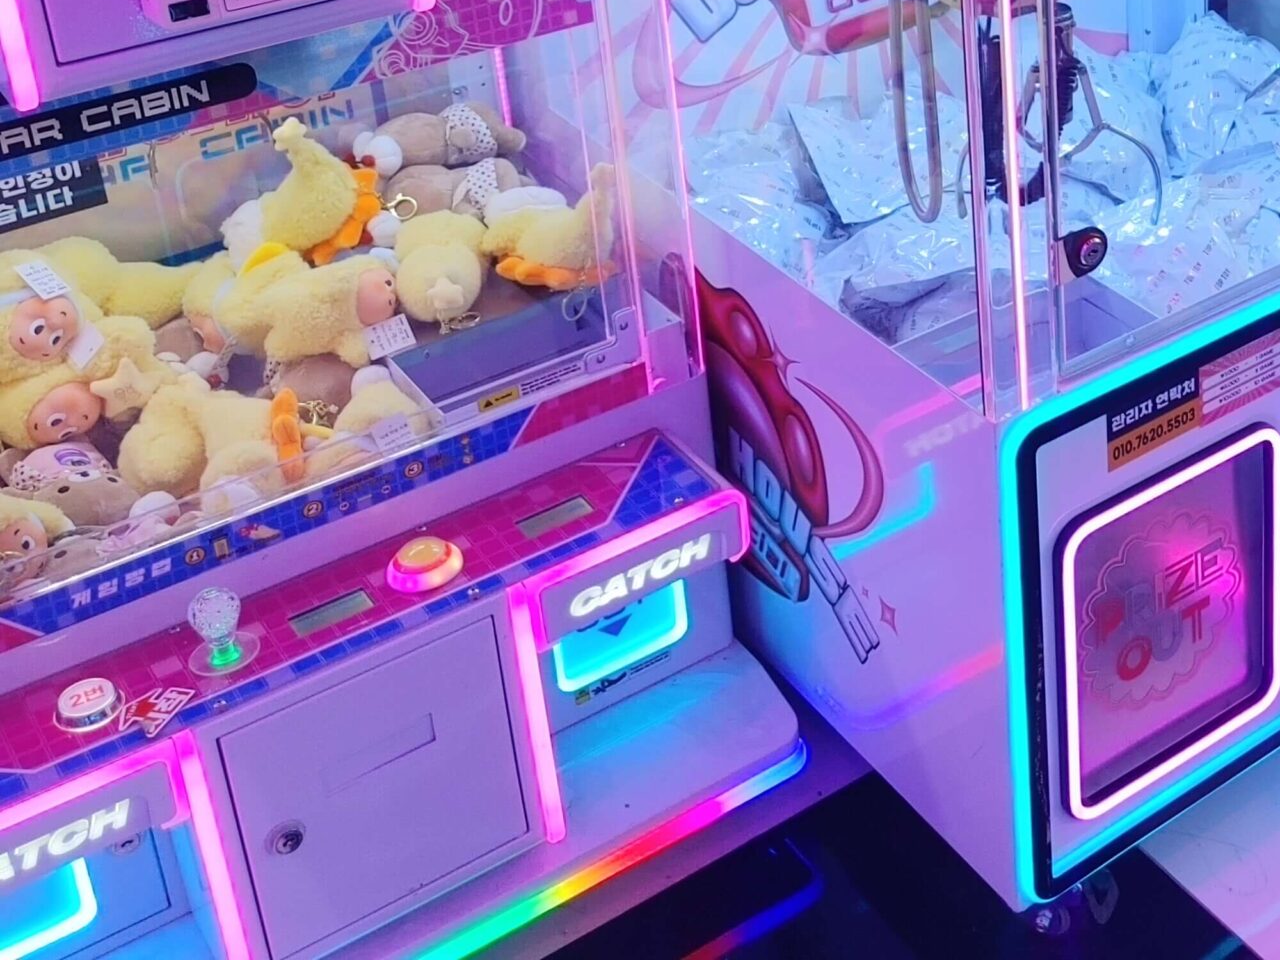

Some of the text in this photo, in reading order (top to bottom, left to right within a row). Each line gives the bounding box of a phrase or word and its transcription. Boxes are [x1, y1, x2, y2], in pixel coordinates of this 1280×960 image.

[80, 79, 211, 134] CABIN
[1111, 376, 1196, 432] 관리자 연락처
[1112, 407, 1196, 460] 010.7620.5503
[569, 533, 712, 618] CATCH
[728, 426, 880, 665] HOUSE
[1097, 537, 1226, 648] PRIZE
[1116, 595, 1211, 682] OUT
[70, 685, 105, 708] 2번
